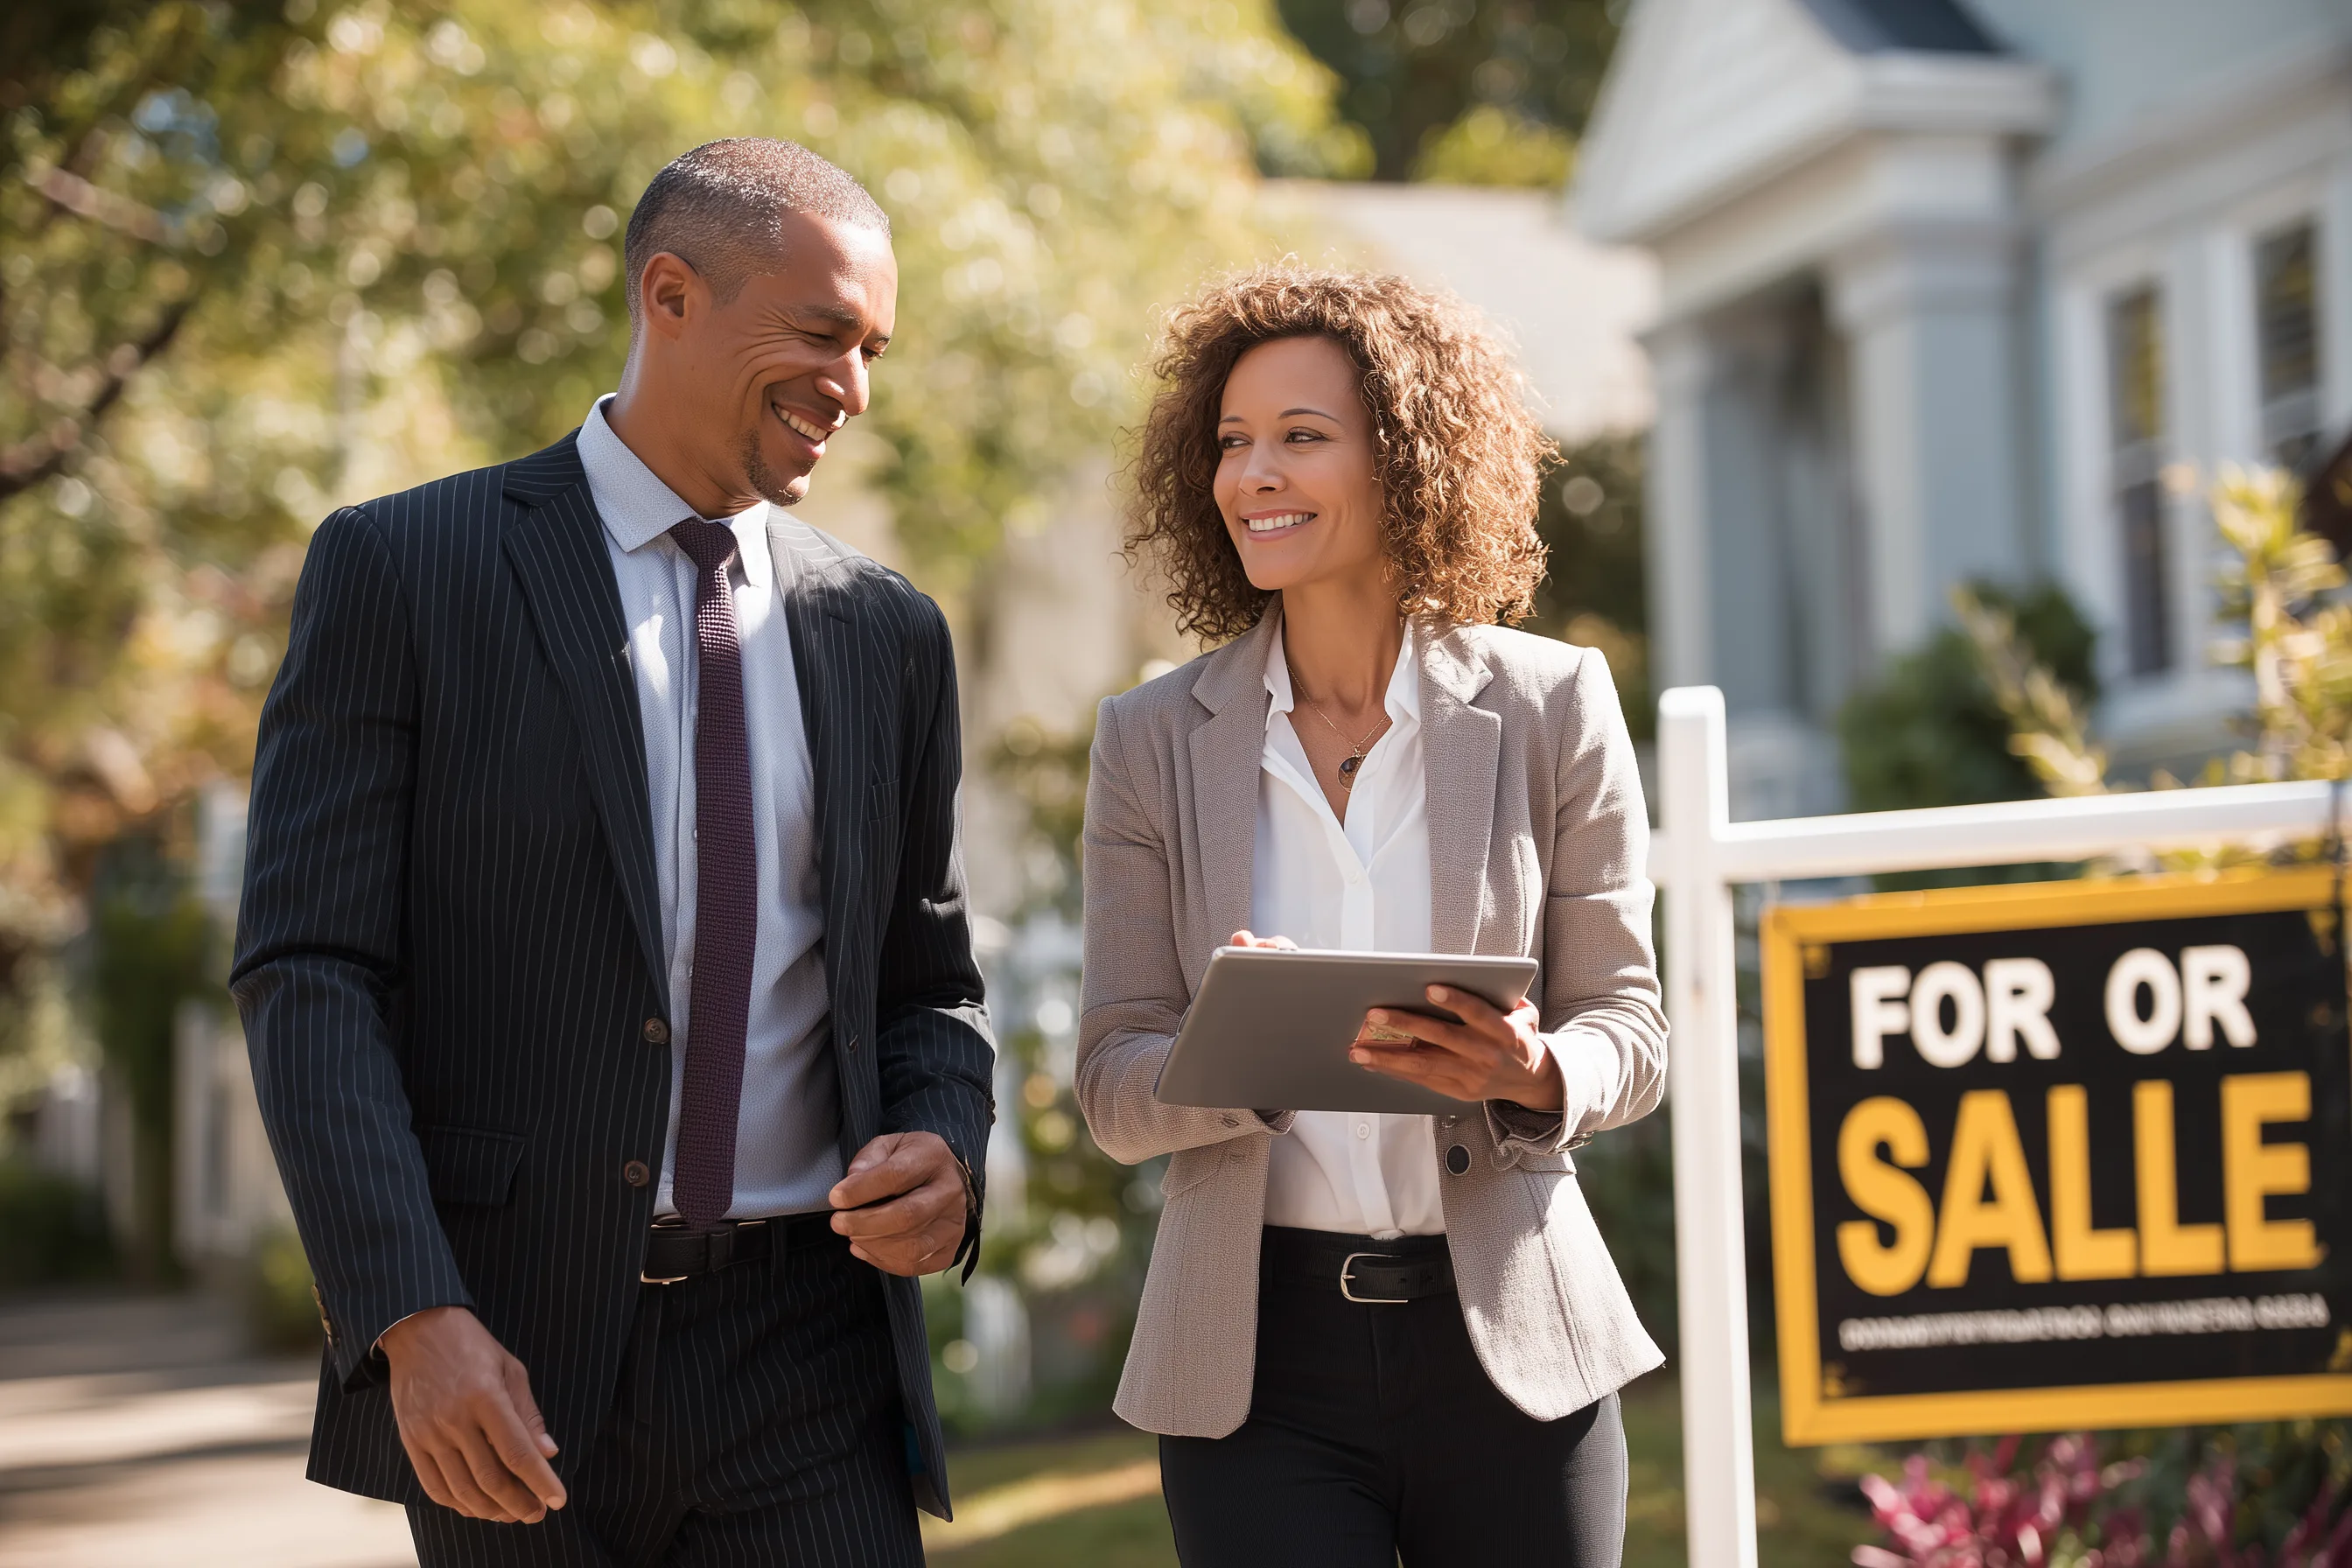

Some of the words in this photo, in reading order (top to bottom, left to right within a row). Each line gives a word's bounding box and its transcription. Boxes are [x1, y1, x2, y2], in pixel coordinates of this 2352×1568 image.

[1850, 957, 2062, 1069] FOR
[2105, 944, 2258, 1055] OR
[1837, 1071, 2318, 1296] SALLE
